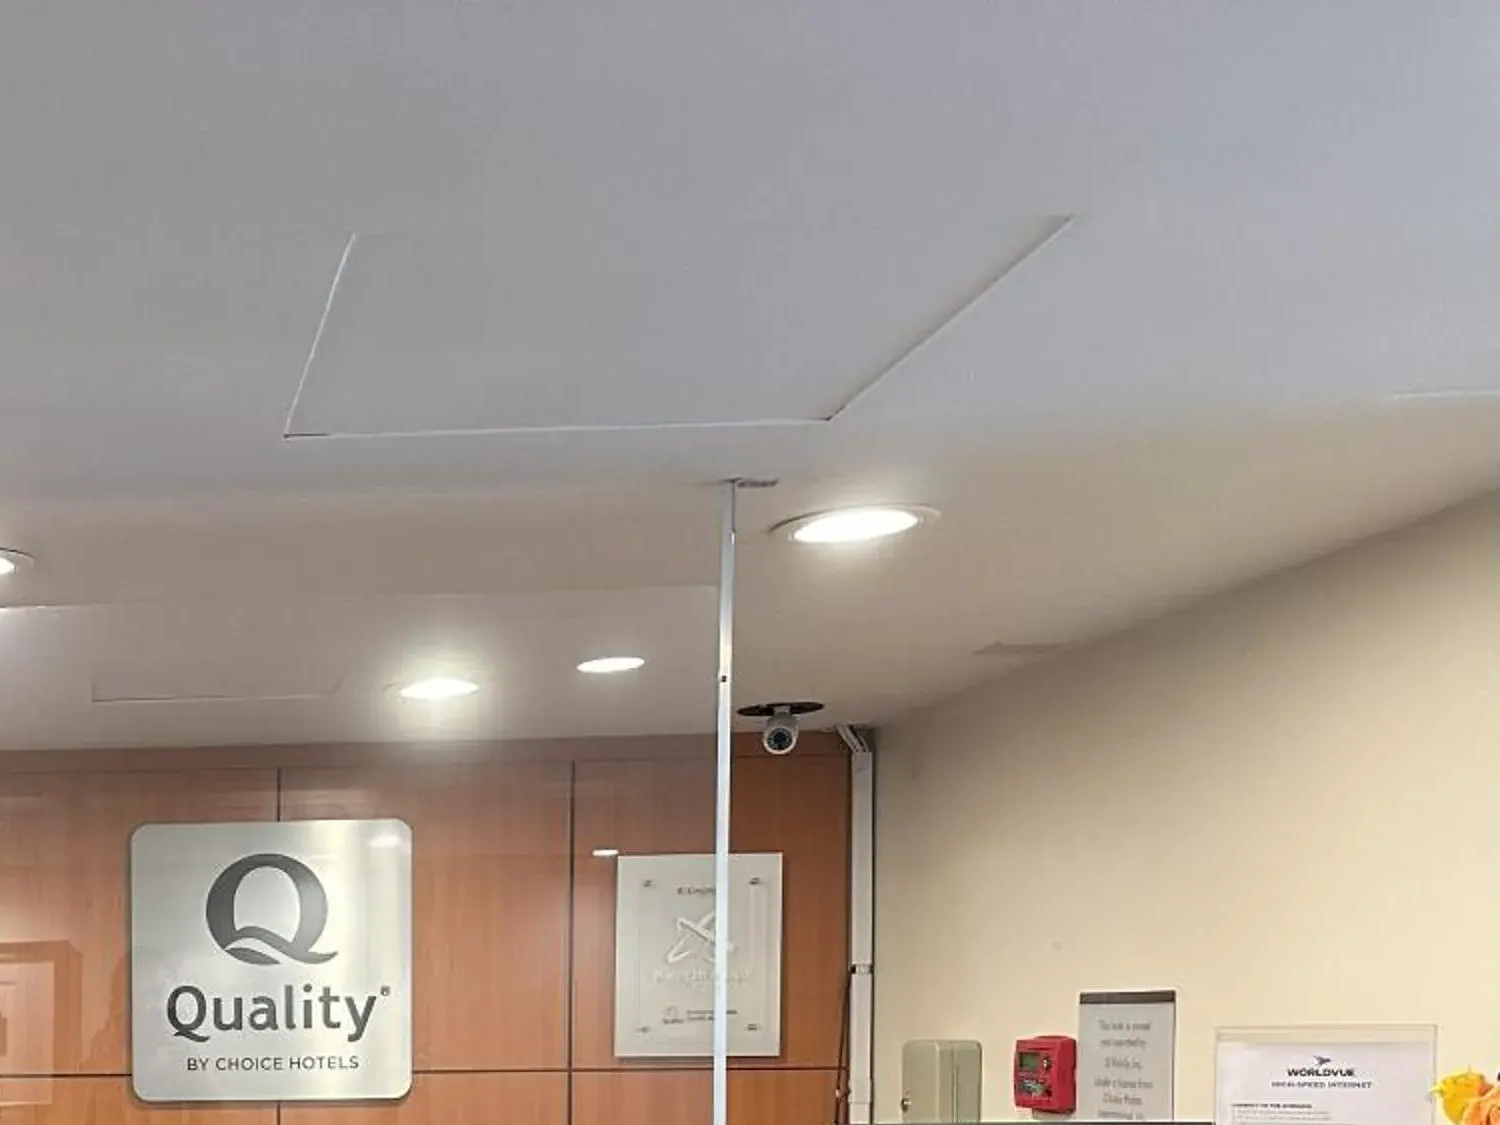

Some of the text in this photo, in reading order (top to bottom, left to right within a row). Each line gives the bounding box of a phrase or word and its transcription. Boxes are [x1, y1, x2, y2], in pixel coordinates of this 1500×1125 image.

[166, 984, 378, 1043] Quality
[187, 1056, 359, 1071] BY CHOICE HOTELS
[1287, 1068, 1356, 1078] WORLDVUE
